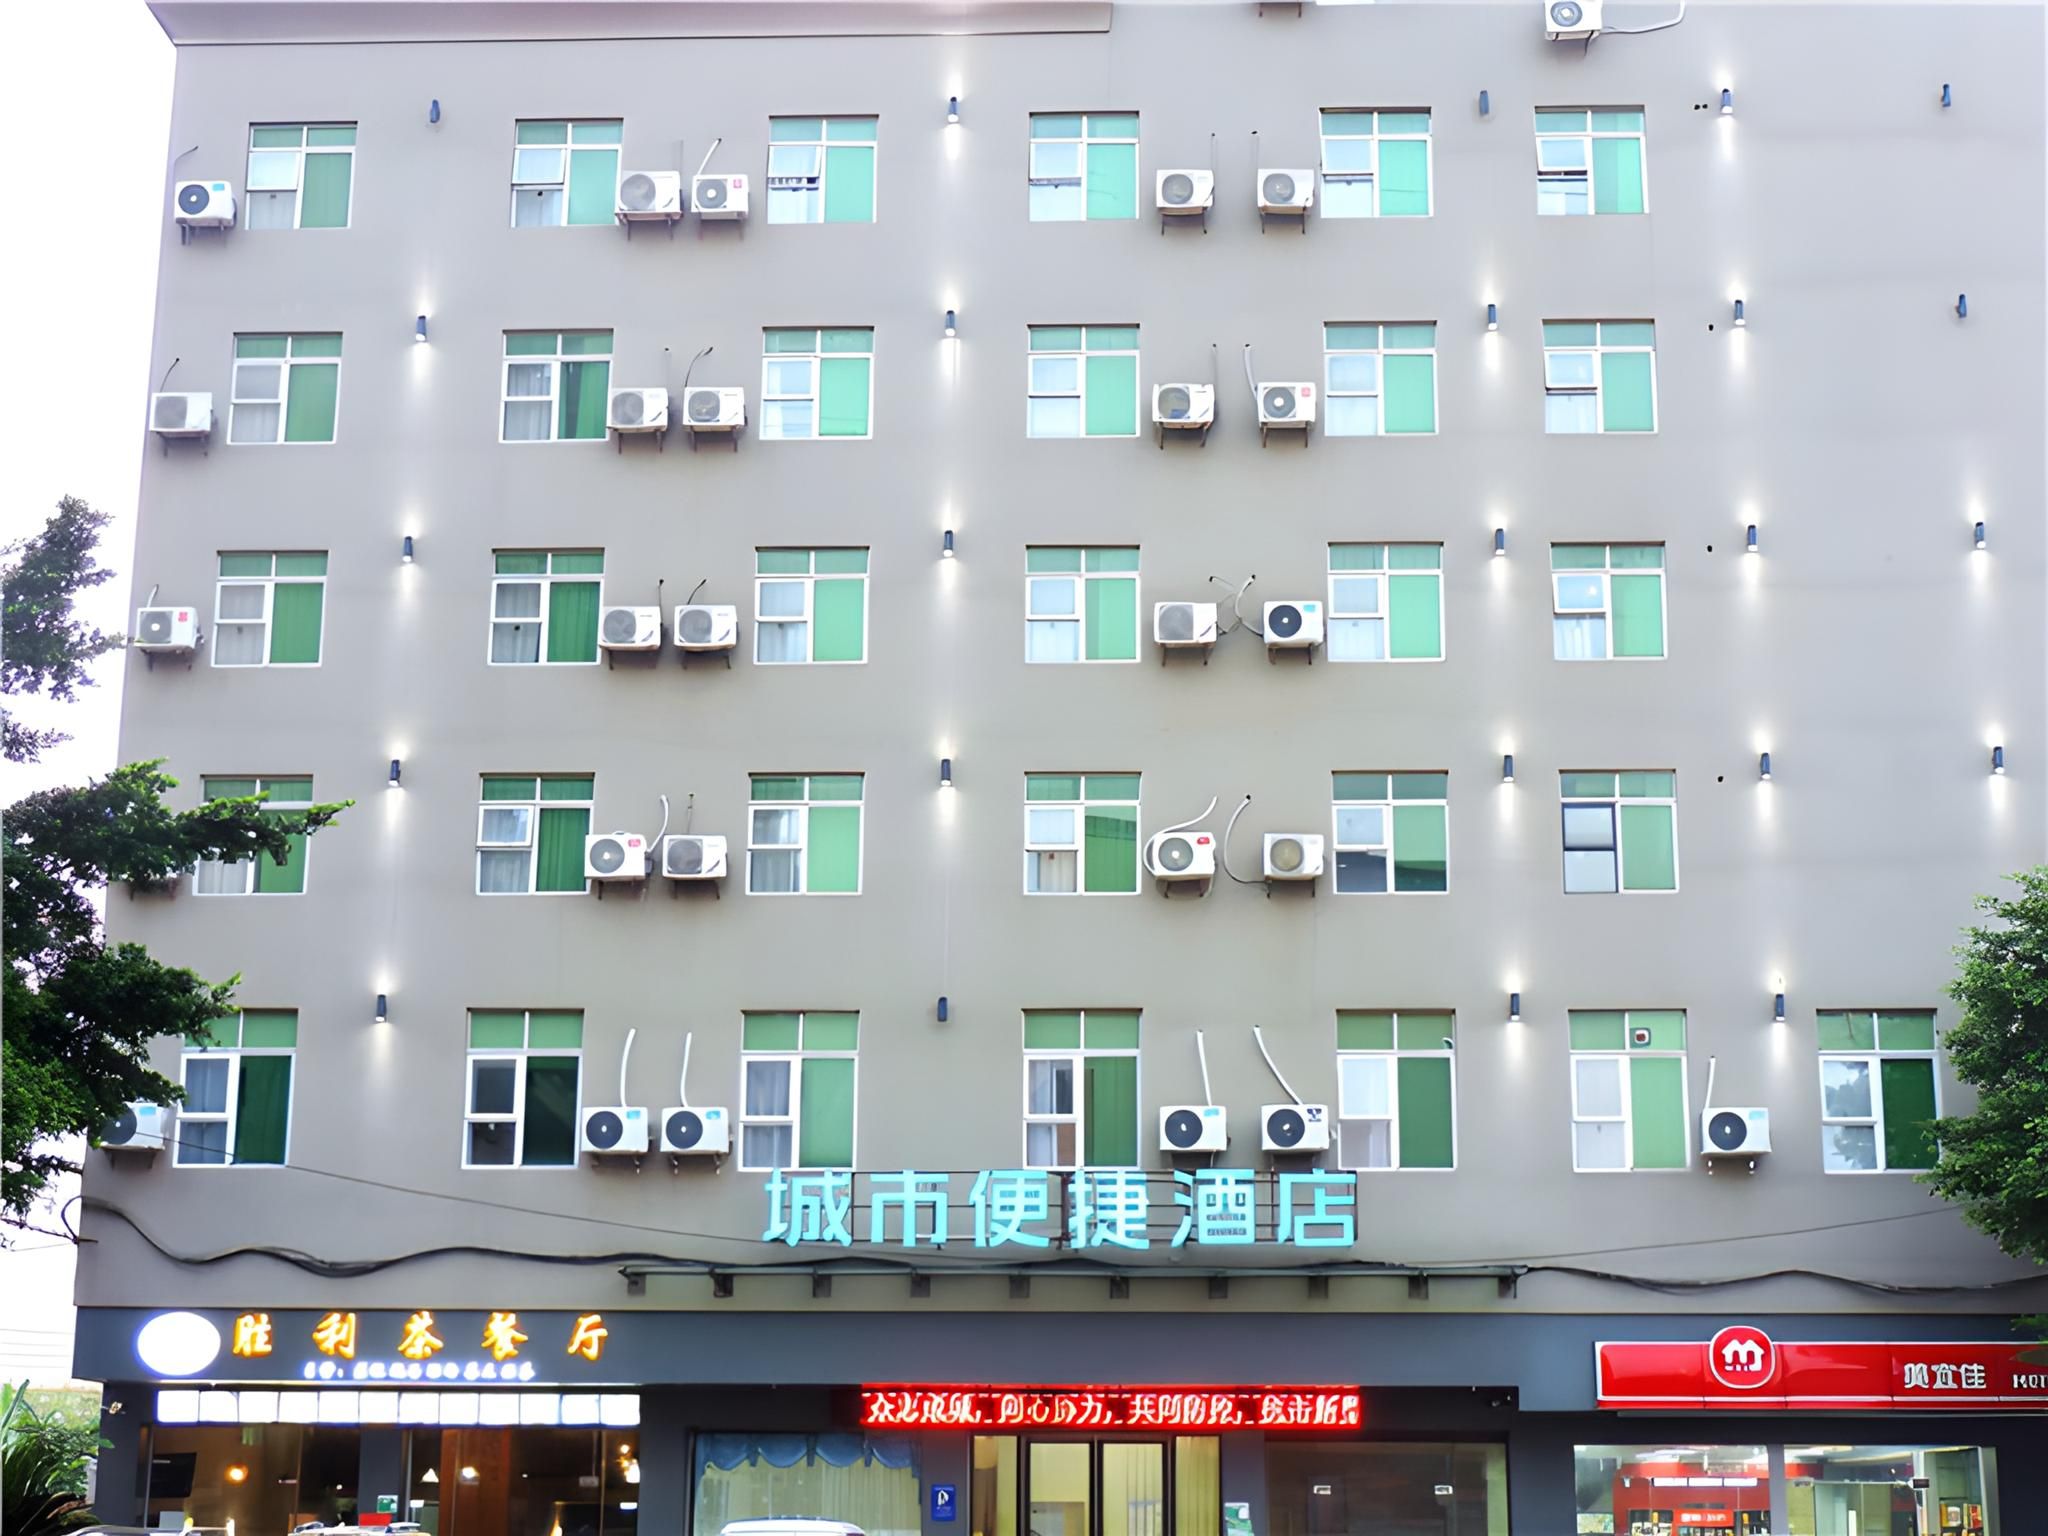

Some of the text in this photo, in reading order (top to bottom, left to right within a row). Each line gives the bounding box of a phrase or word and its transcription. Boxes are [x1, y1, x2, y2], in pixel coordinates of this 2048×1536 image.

[763, 1169, 1356, 1249] 城市便捷酒店
[232, 1311, 609, 1361] 胜利茶餐厅
